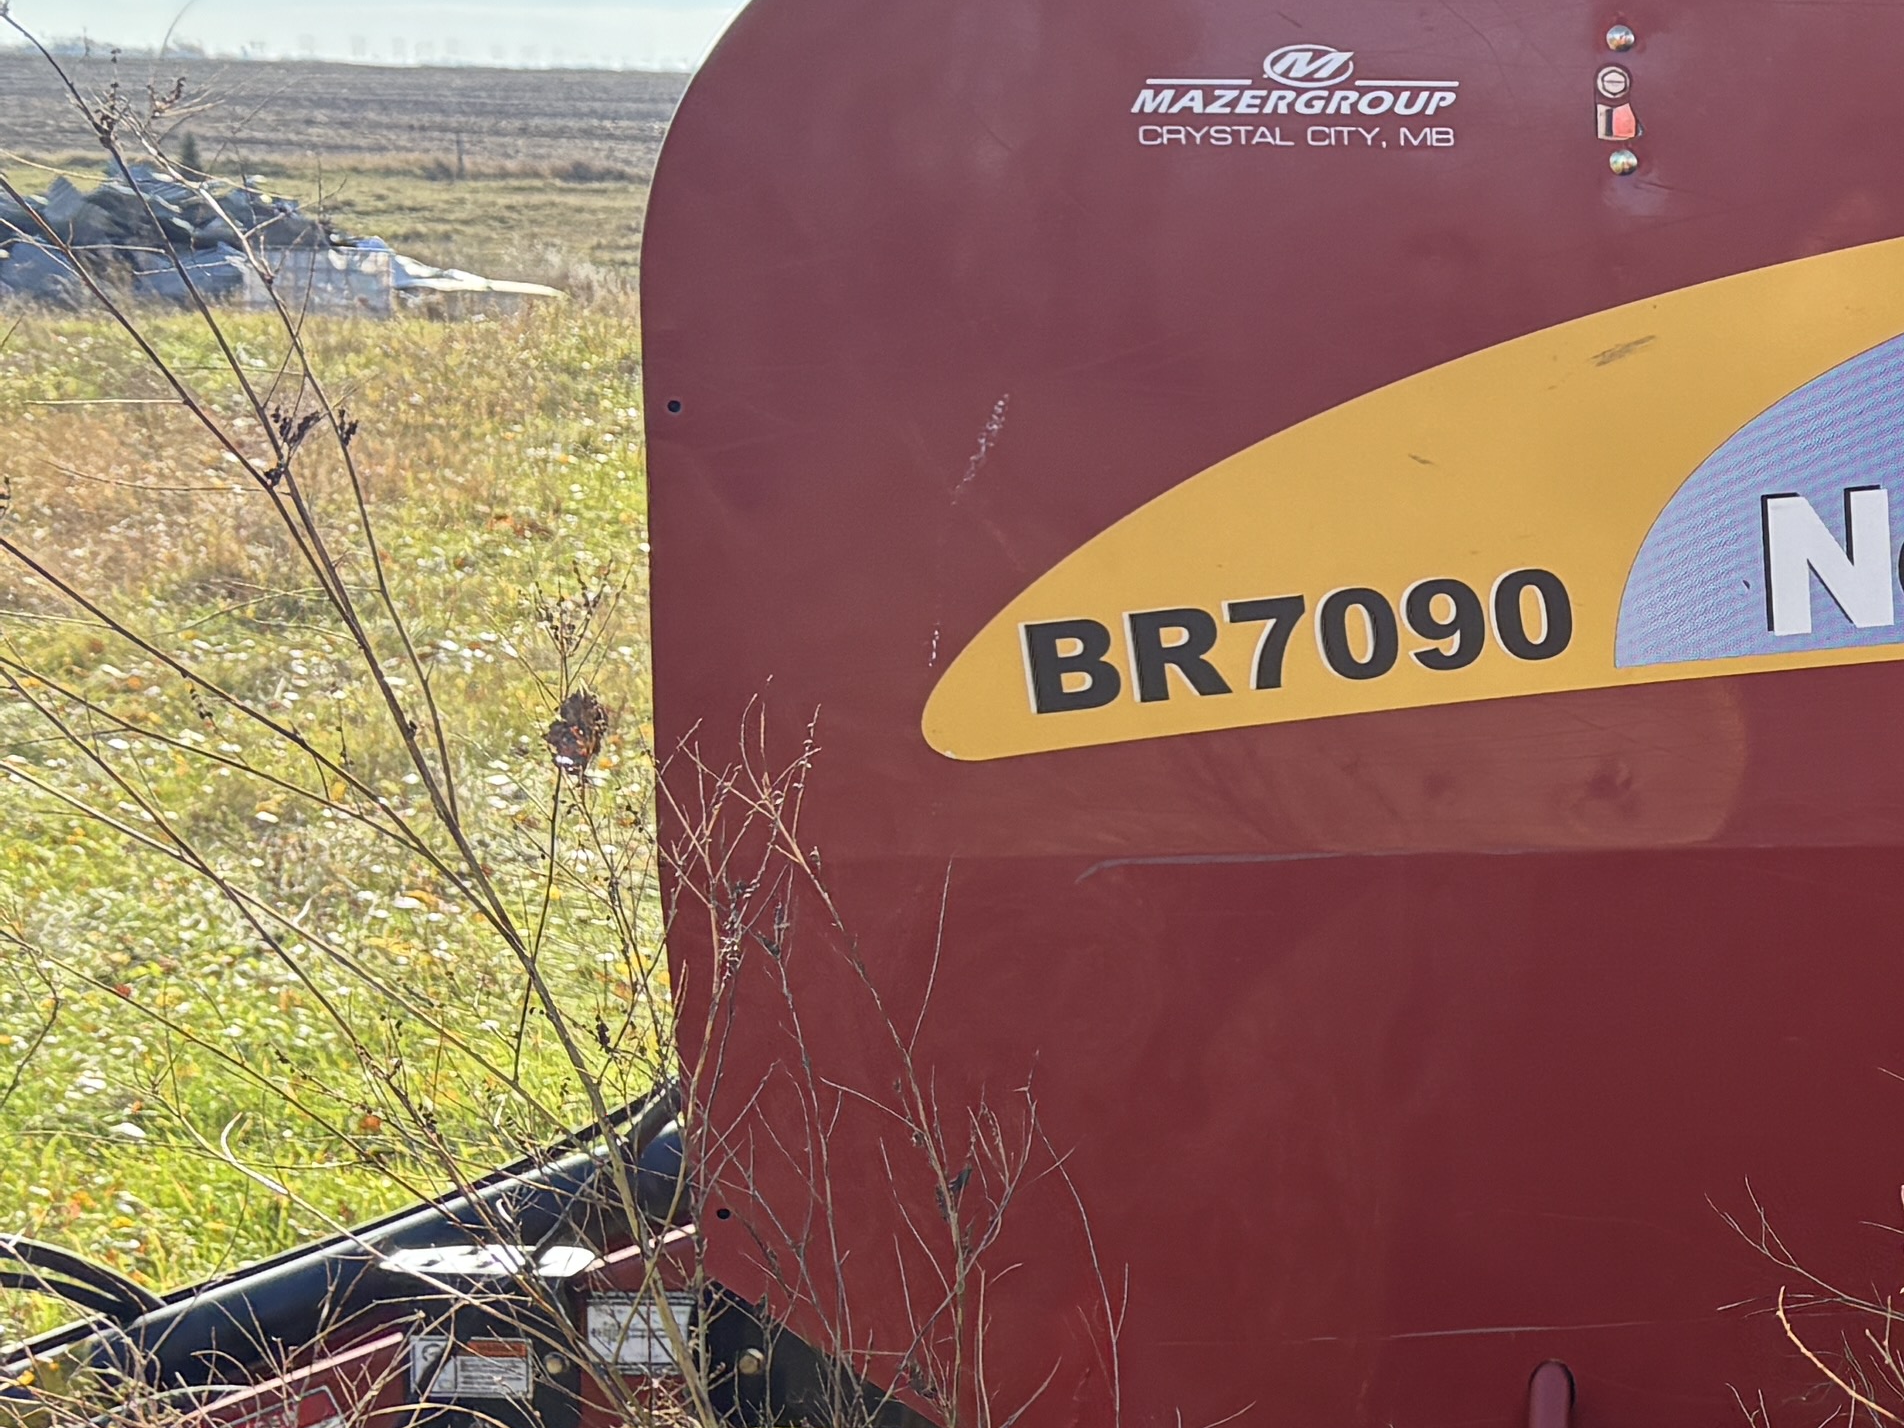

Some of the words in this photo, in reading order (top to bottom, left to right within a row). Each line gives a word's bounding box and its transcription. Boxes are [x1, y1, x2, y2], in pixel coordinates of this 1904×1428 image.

[1130, 88, 1457, 116] MAZERGROUP
[1138, 124, 1296, 146] CRYSTAL
[1306, 125, 1387, 149] CITY,
[1399, 126, 1455, 147] MB
[1018, 568, 1574, 715] BR7090
